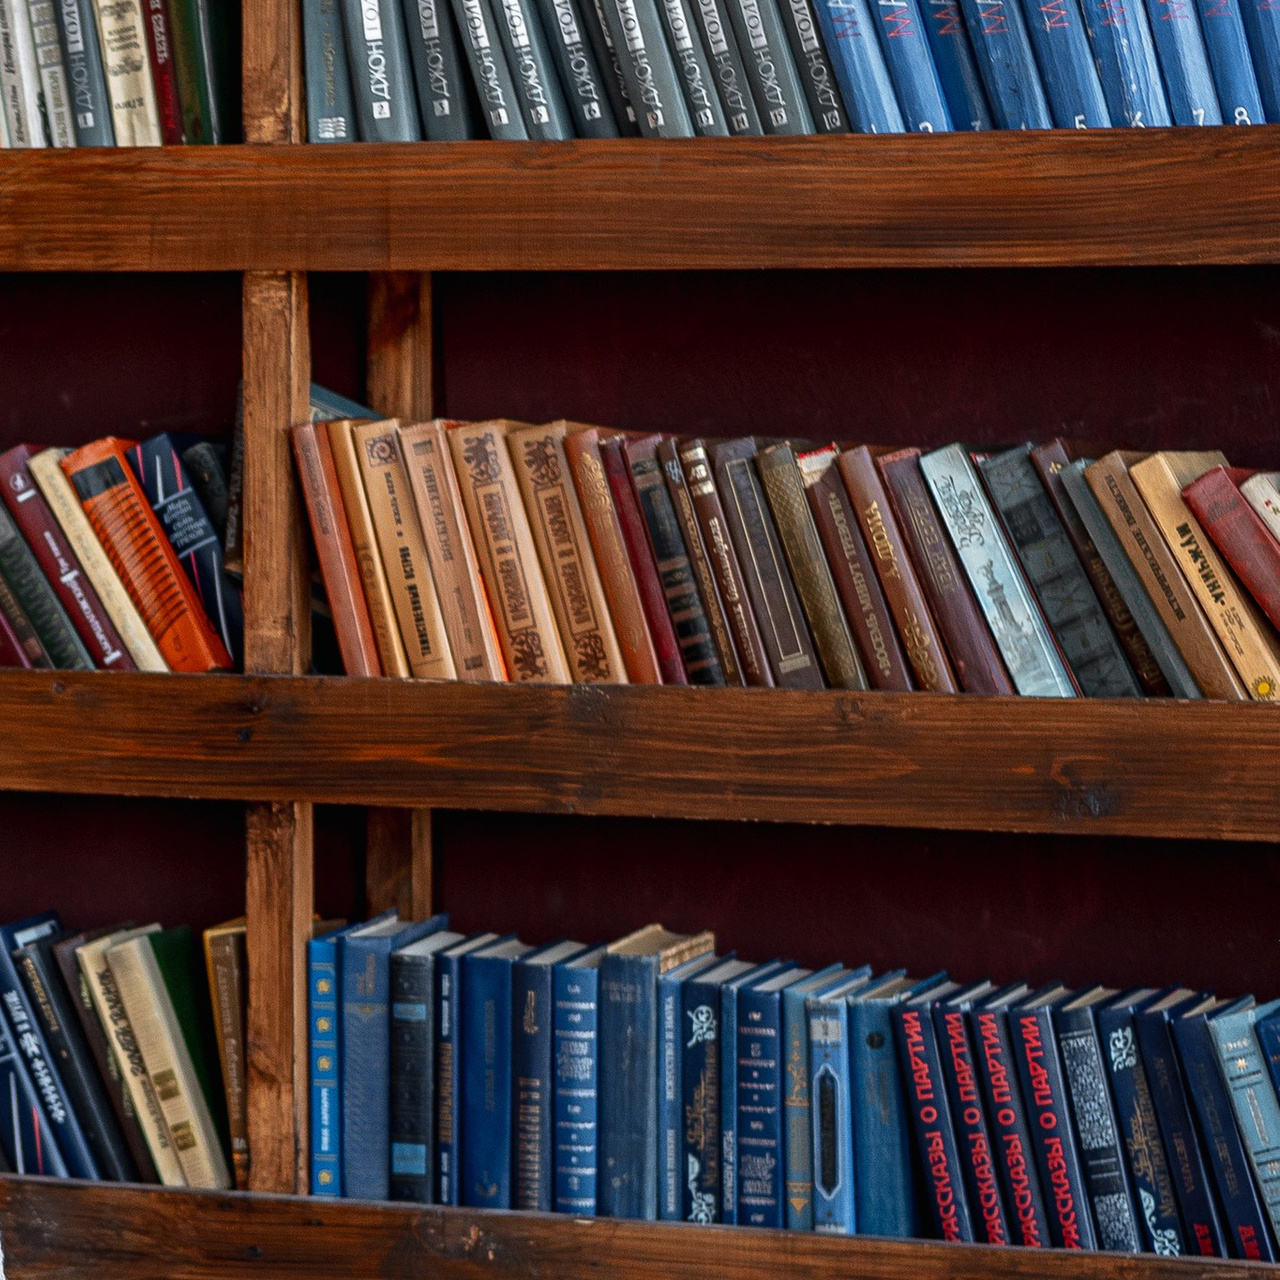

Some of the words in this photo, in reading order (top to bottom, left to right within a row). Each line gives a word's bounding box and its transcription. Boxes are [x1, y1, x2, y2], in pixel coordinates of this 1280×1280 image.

[152, 13, 168, 64] ЧЕРЕЗ
[424, 38, 449, 97] ДЖОН
[70, 53, 94, 110] ДЖОН
[366, 41, 391, 100] ДЖОН
[475, 48, 505, 105] ДЖОН
[517, 45, 546, 104] ДЖОН
[568, 43, 599, 100] ДЖОН
[632, 49, 662, 107] ДЖОН
[682, 49, 711, 106] ДЖОН
[714, 52, 746, 110] ДЖОН
[755, 47, 786, 105] ДЖОН
[806, 49, 838, 108] ДЖОН
[1104, 474, 1140, 526] ПОВЕСТИ
[399, 546, 415, 579] ОСТРОВ
[845, 561, 874, 611] МИНУТ
[1130, 528, 1187, 622] ИСТОРИЧЕСКИЕ
[1175, 522, 1226, 602] МУЖЧИНА
[404, 583, 432, 657] ТАИНСТВЕННЫЙ
[902, 1011, 934, 1101] ПАРТИИ
[944, 1013, 977, 1103] ПАРТИИ
[978, 1013, 1012, 1103] ПАРТИИ
[1020, 1016, 1054, 1106] ПАРТИИ
[919, 1105, 938, 1124] О
[962, 1107, 982, 1126] О
[997, 1109, 1016, 1126] О
[1038, 1112, 1057, 1131] О
[924, 1132, 962, 1243] РАССКАЗЫ
[967, 1132, 1005, 1246] РАССКАЗЫ
[1002, 1133, 1041, 1248] РАССКАЗЫ
[1043, 1137, 1082, 1250] РАССКАЗЫ
